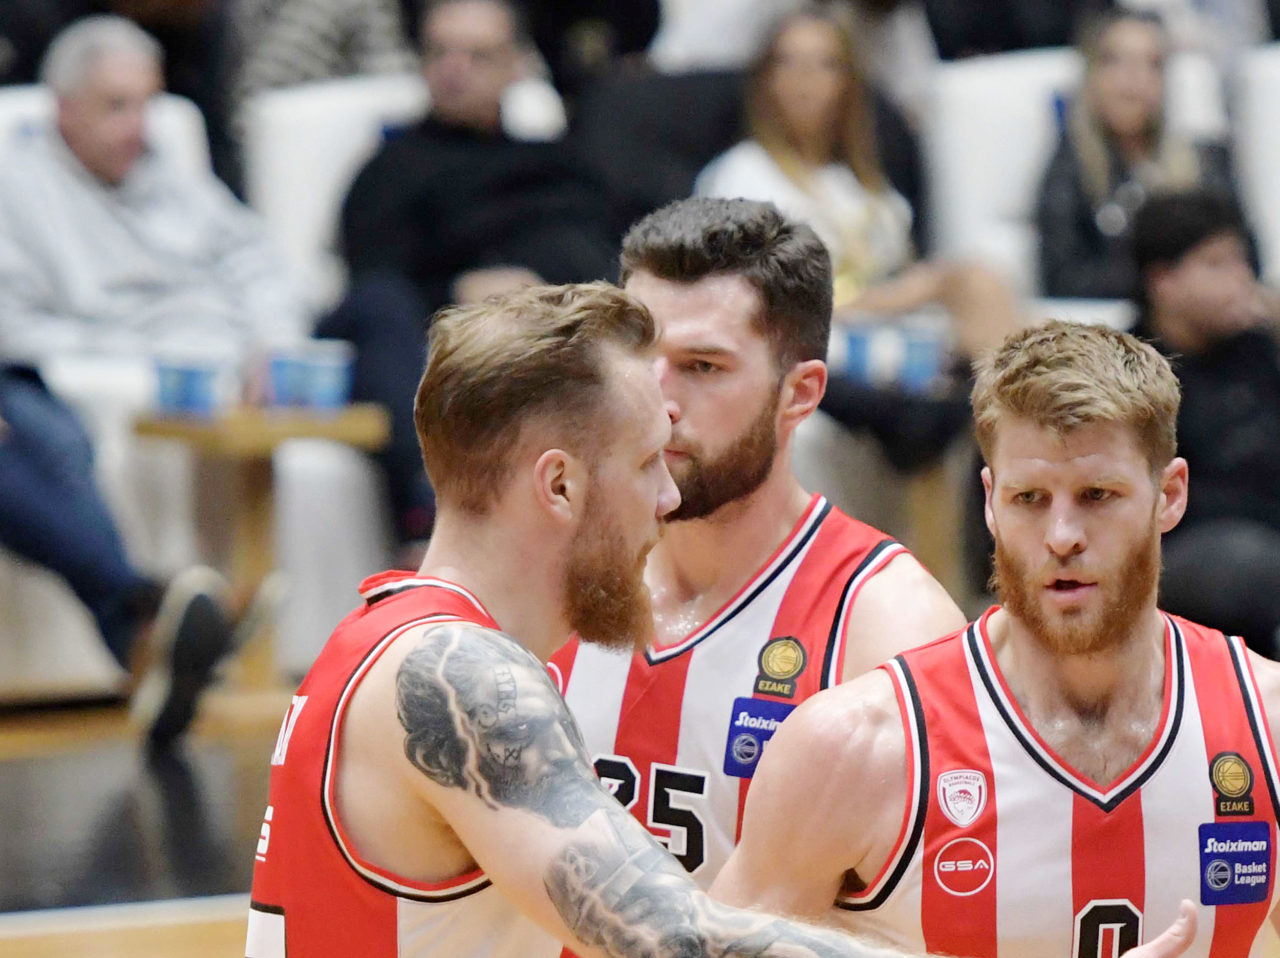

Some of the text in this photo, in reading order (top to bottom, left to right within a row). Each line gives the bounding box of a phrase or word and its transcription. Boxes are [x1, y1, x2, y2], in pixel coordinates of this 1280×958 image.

[1220, 801, 1250, 812] ΕΣΑΚΕ
[1204, 838, 1267, 853] Stoiximan
[939, 859, 989, 872] GSA
[1234, 862, 1267, 874] Basket
[1234, 873, 1267, 886] League
